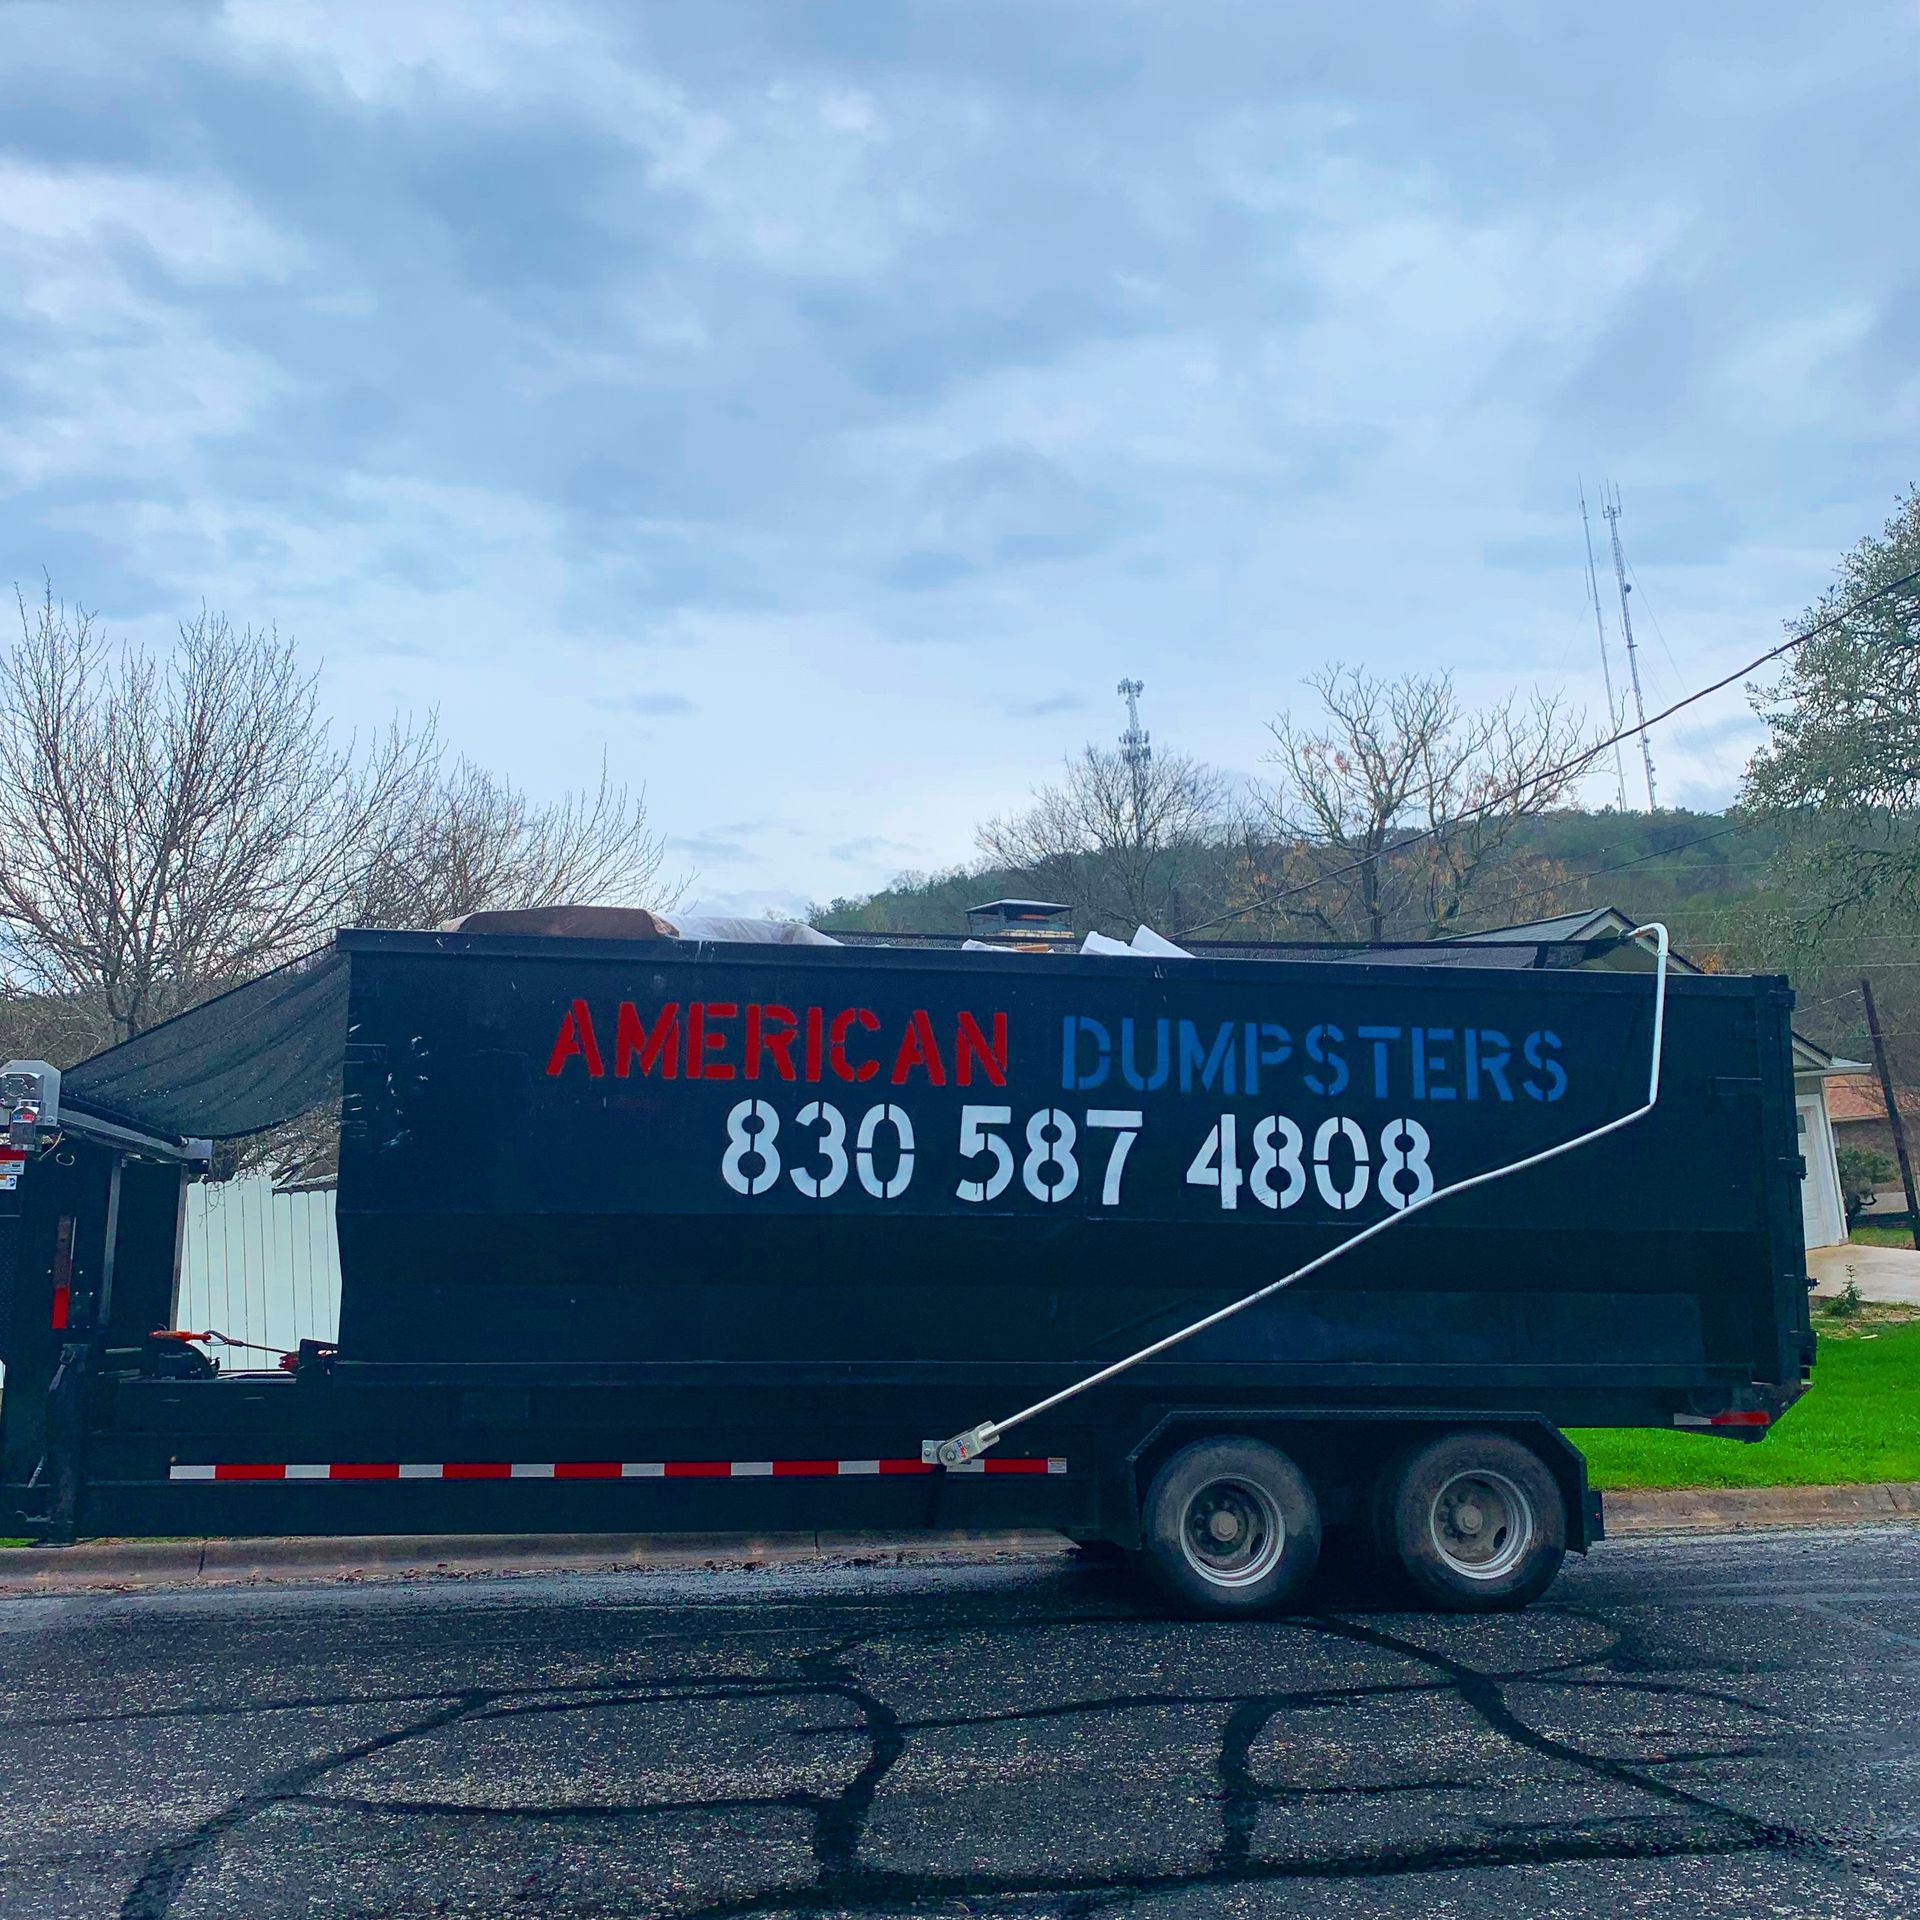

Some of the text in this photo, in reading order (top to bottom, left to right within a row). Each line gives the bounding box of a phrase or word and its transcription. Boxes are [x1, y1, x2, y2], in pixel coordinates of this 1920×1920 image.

[546, 999, 1568, 1102] AMERICAN DUMPSTERS
[721, 1099, 1434, 1210] 830 587 4808
